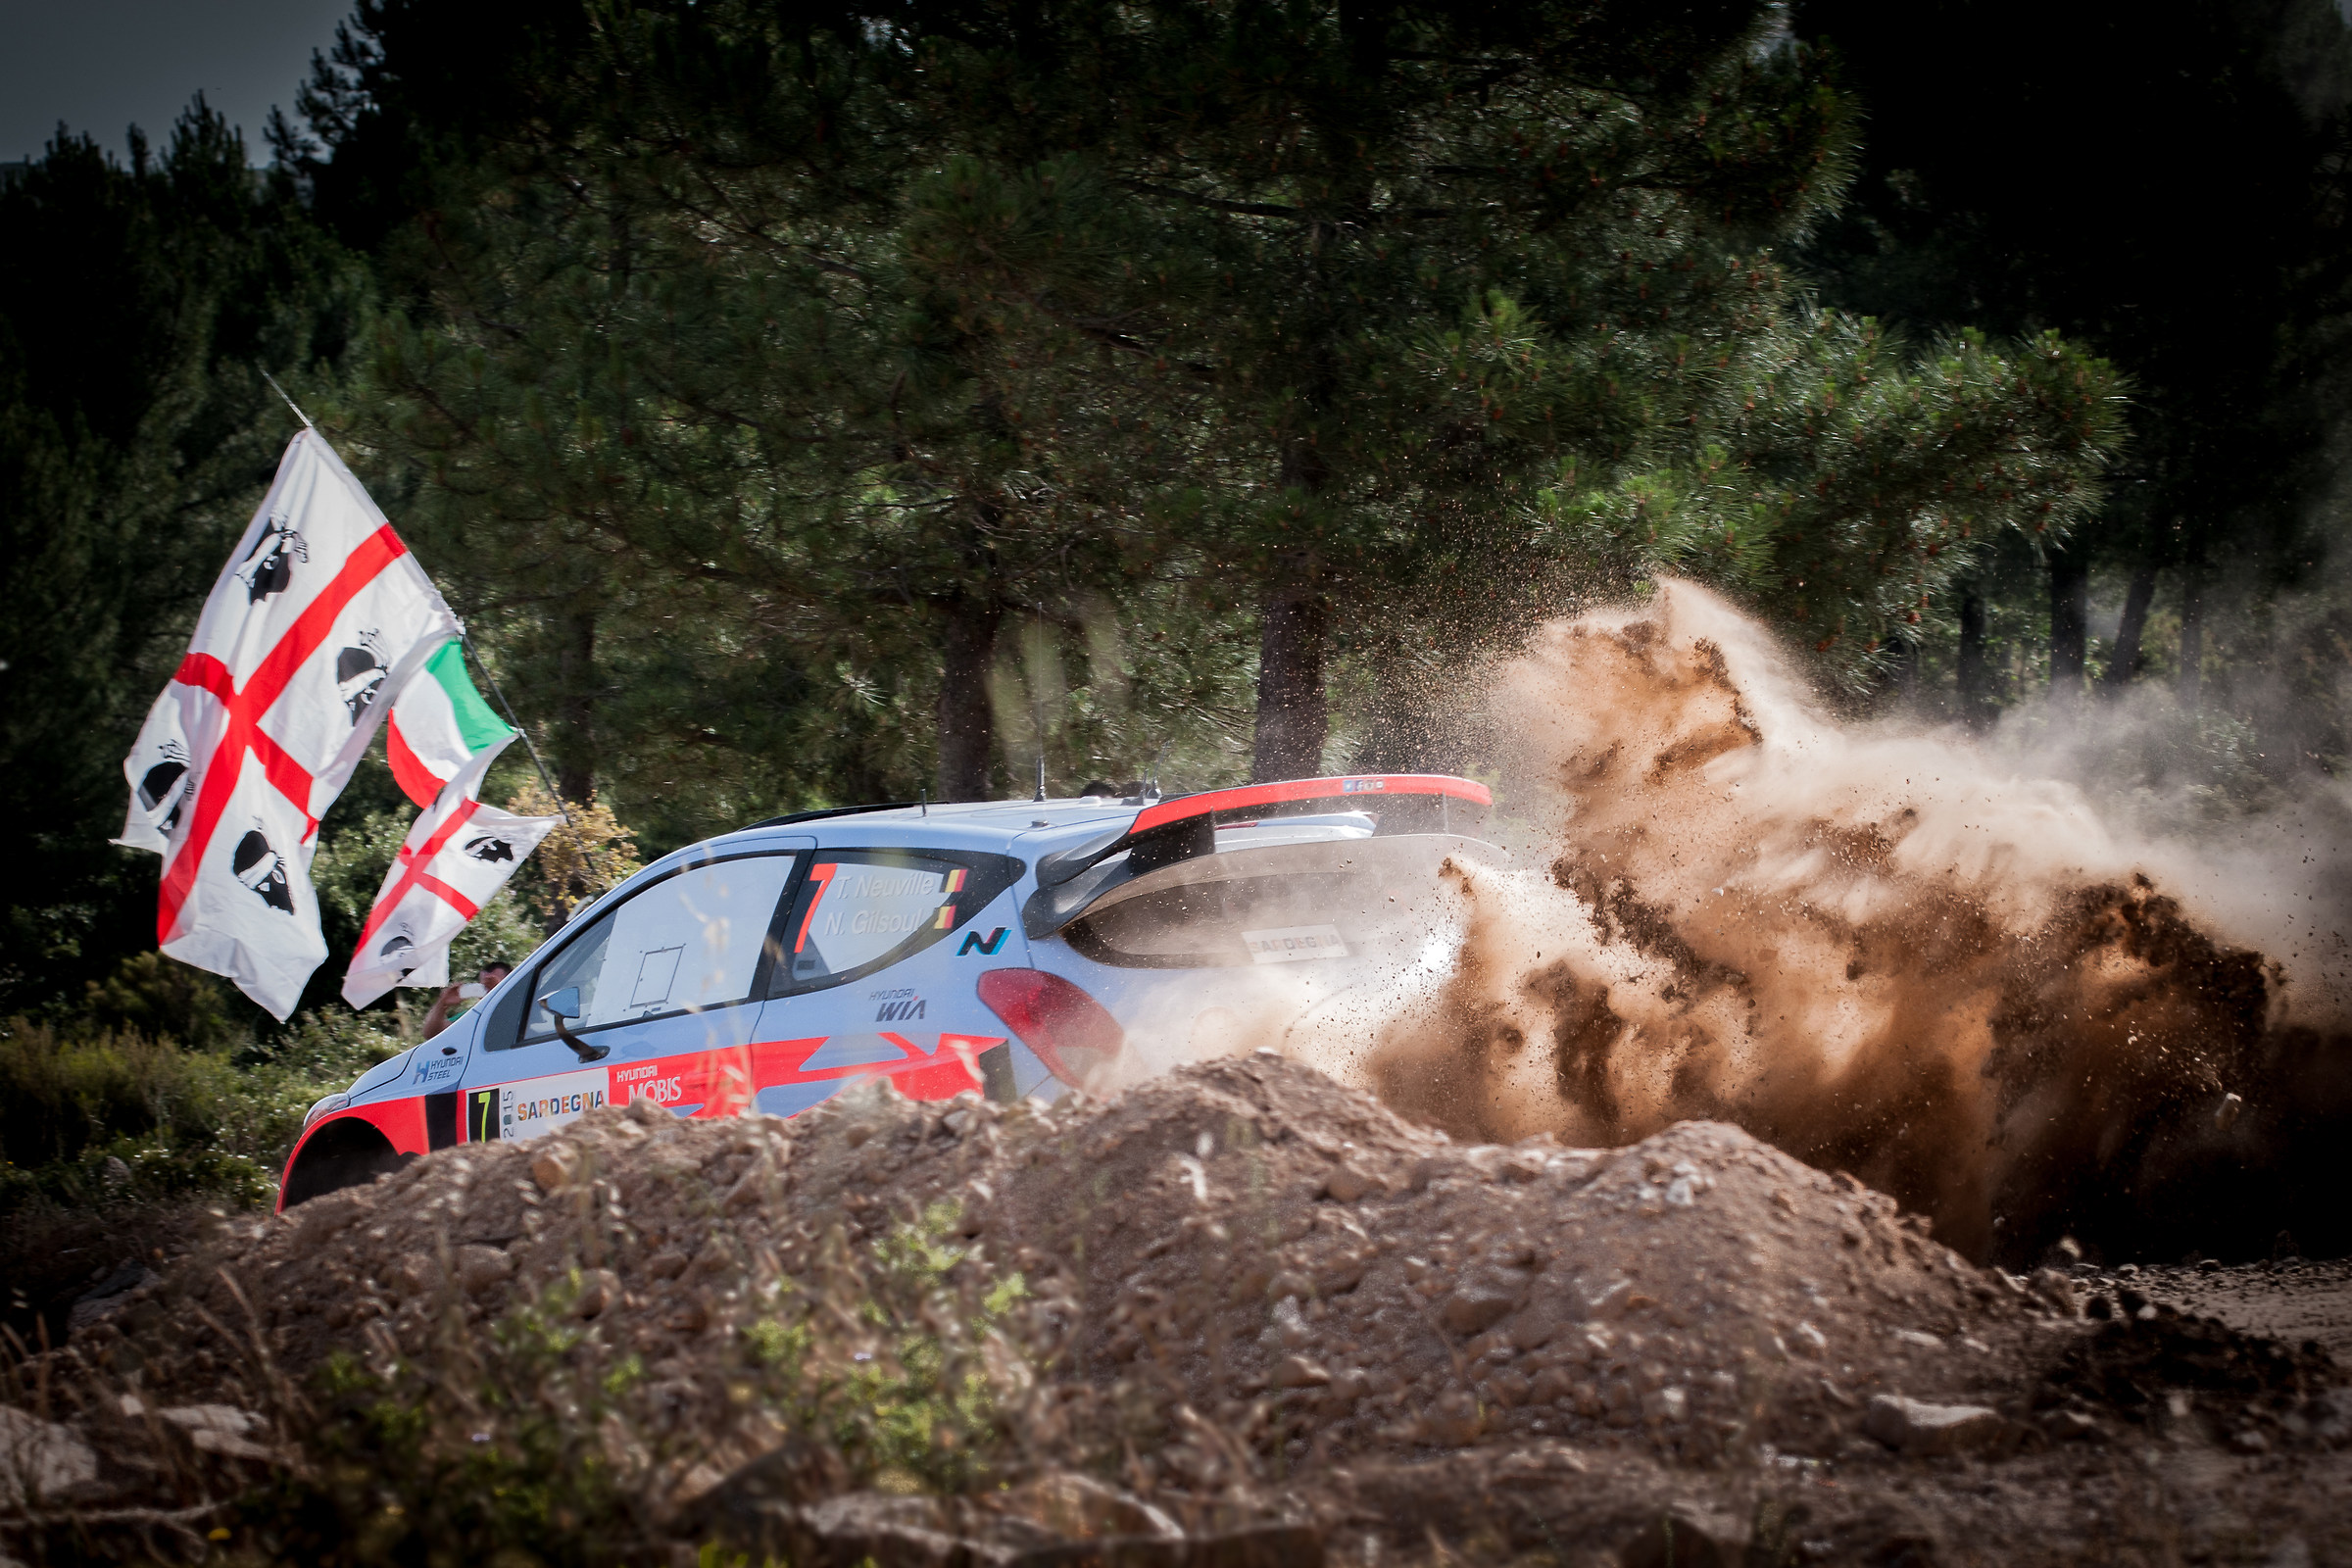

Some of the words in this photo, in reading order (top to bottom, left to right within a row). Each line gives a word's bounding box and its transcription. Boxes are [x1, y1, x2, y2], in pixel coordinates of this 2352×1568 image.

[837, 875, 853, 900] T.
[855, 871, 934, 899] Neuville
[794, 862, 838, 954] 7
[824, 911, 845, 937] N.
[851, 907, 924, 936] Gilsoul
[956, 926, 1012, 956] N
[869, 988, 915, 1001] HYUNDAI
[875, 999, 926, 1022] WIA
[427, 1069, 451, 1082] STEEL
[430, 1055, 464, 1070] HYUNDAI
[616, 1064, 658, 1083] HYUNDAI
[628, 1076, 682, 1105] MOBIS
[478, 1091, 491, 1144] 7
[517, 1090, 605, 1121] SARDEGNA
